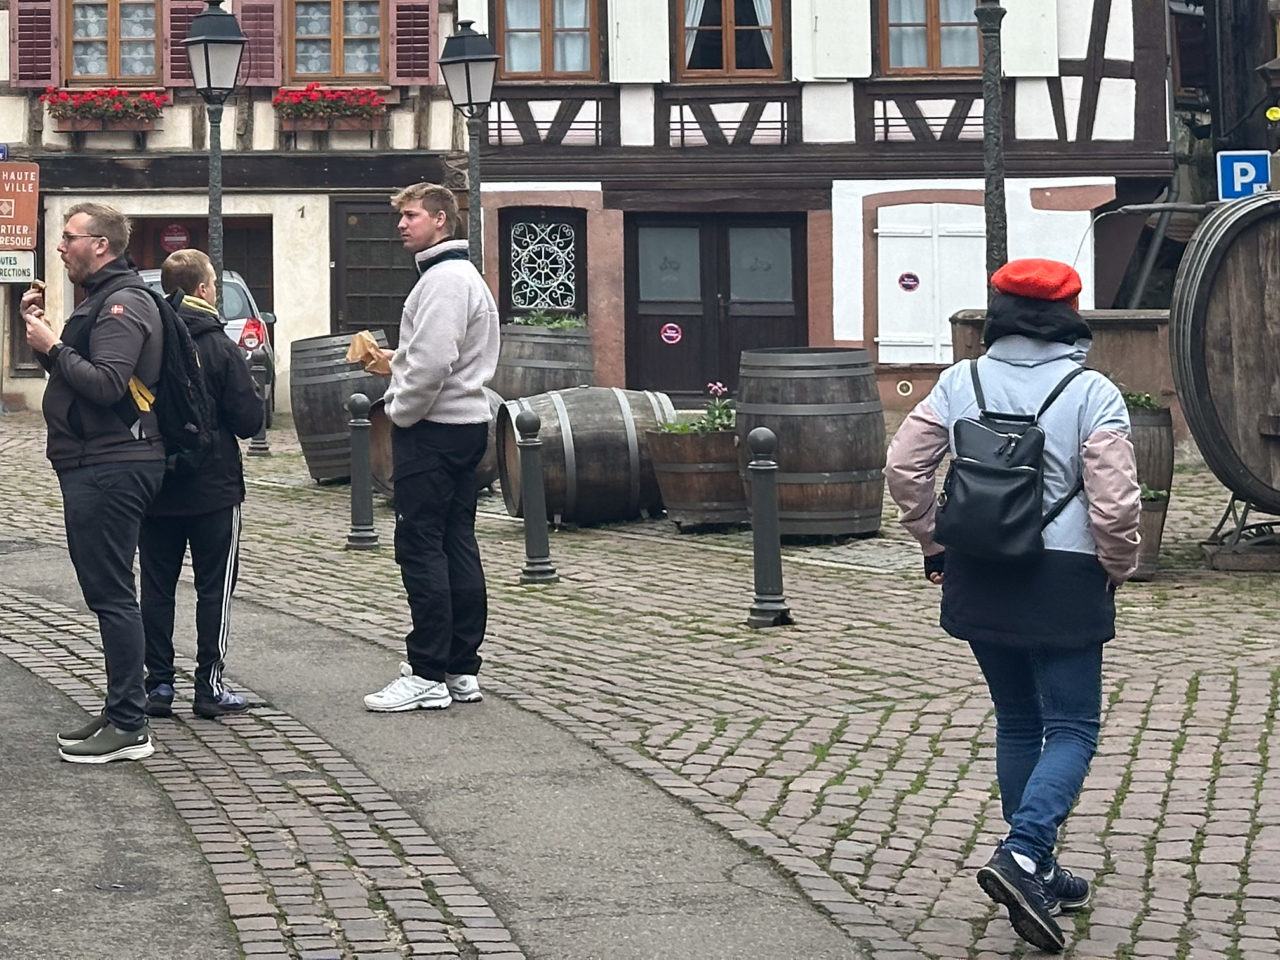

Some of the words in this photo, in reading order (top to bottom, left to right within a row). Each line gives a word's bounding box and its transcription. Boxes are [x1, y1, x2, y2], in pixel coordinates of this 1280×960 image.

[2, 171, 36, 181] HAUTE
[1232, 161, 1256, 192] P
[4, 183, 34, 193] VILLE
[297, 205, 305, 219] 1
